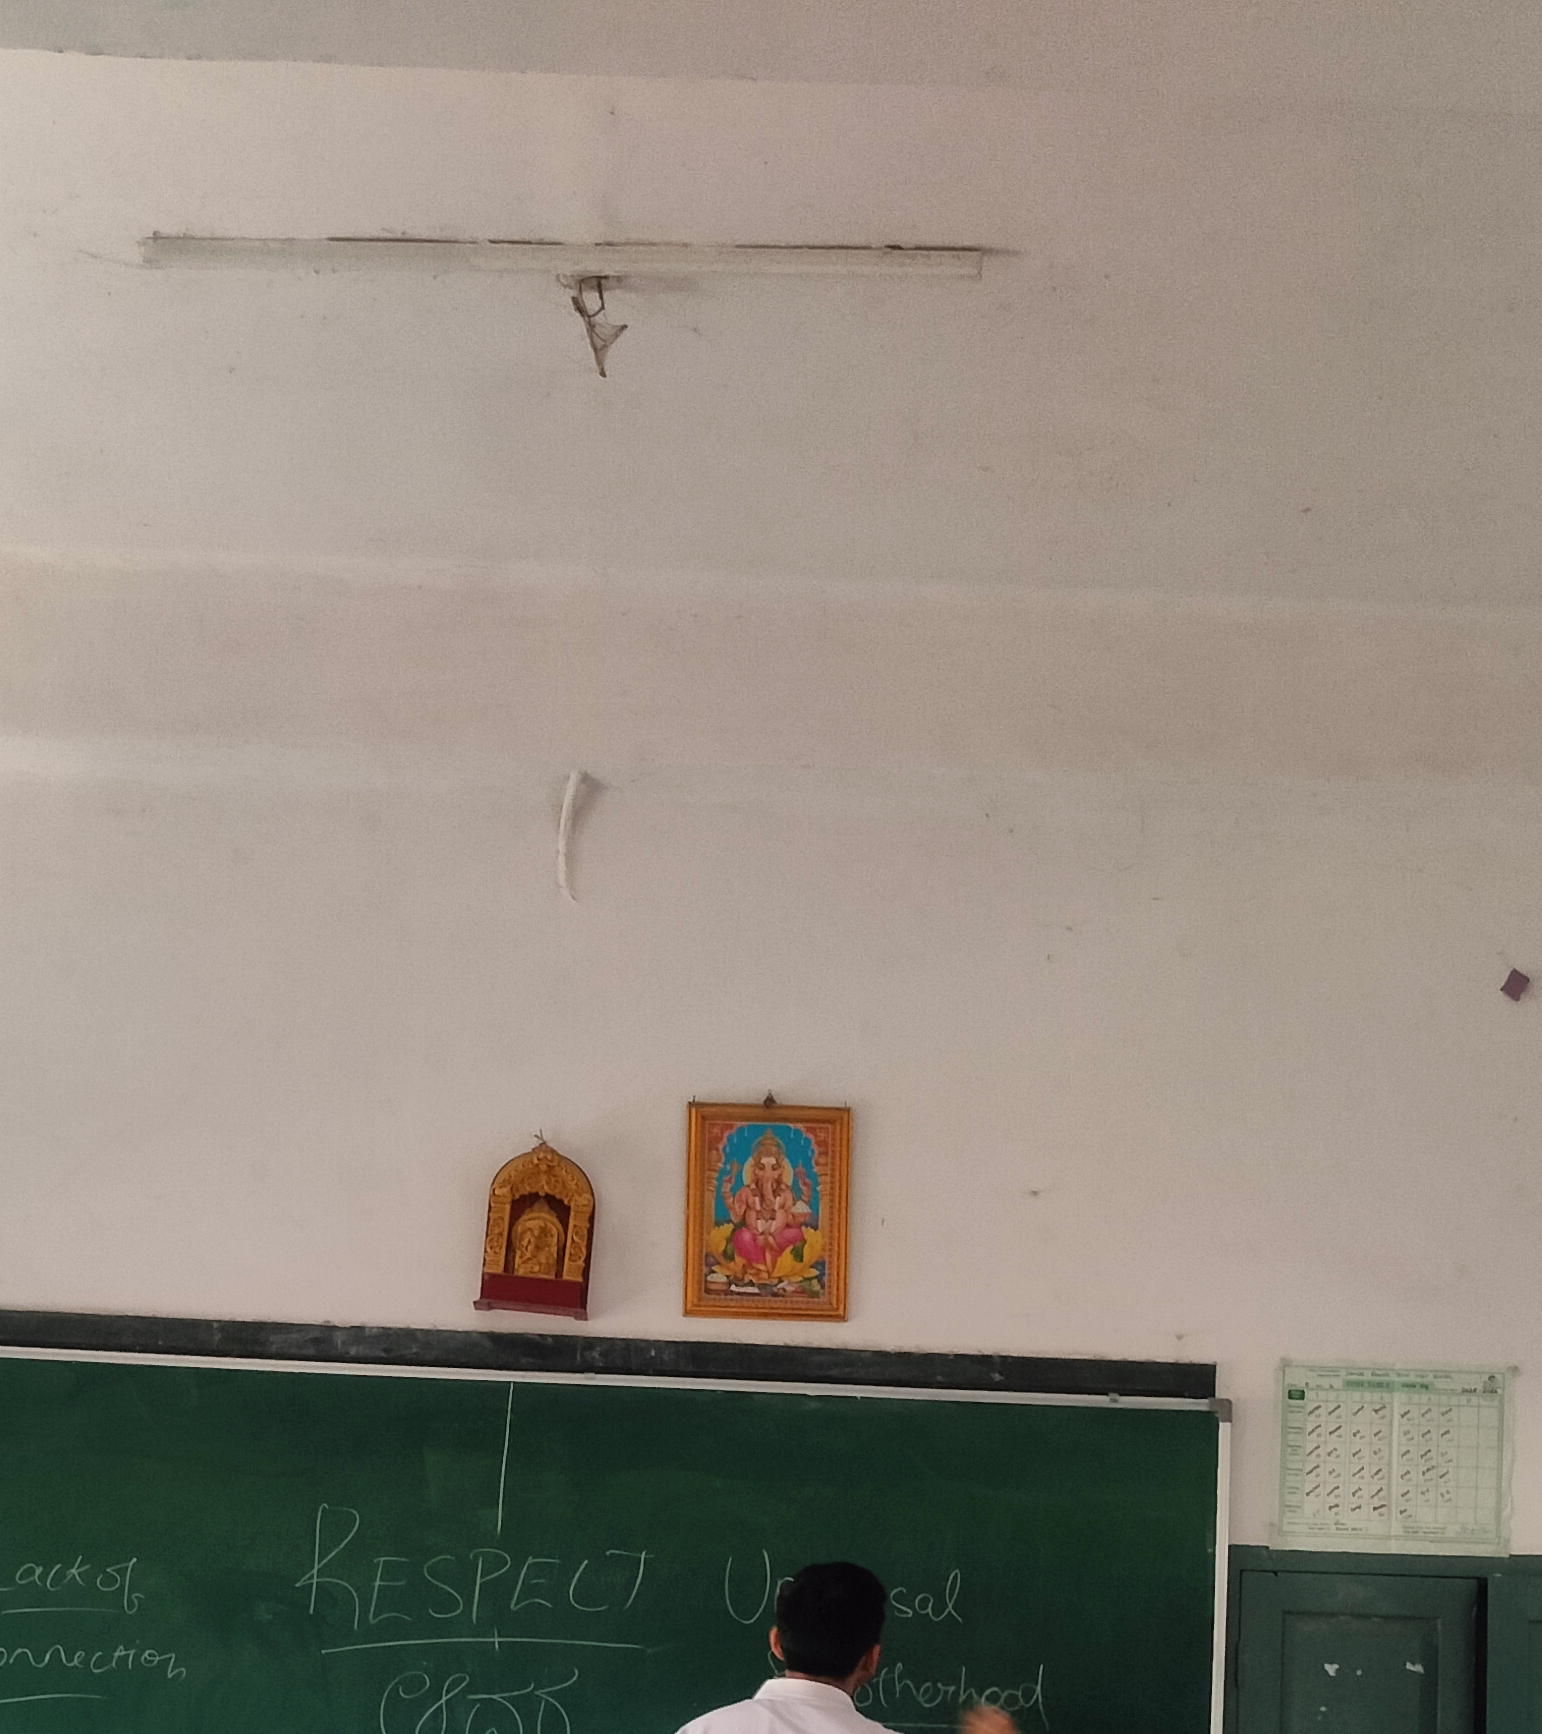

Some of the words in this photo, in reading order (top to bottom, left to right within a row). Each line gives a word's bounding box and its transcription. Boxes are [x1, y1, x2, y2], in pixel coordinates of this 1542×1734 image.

[96, 1556, 146, 1615] of
[295, 1502, 655, 1631] RESPECT
[767, 1650, 1050, 1731] otherhood
